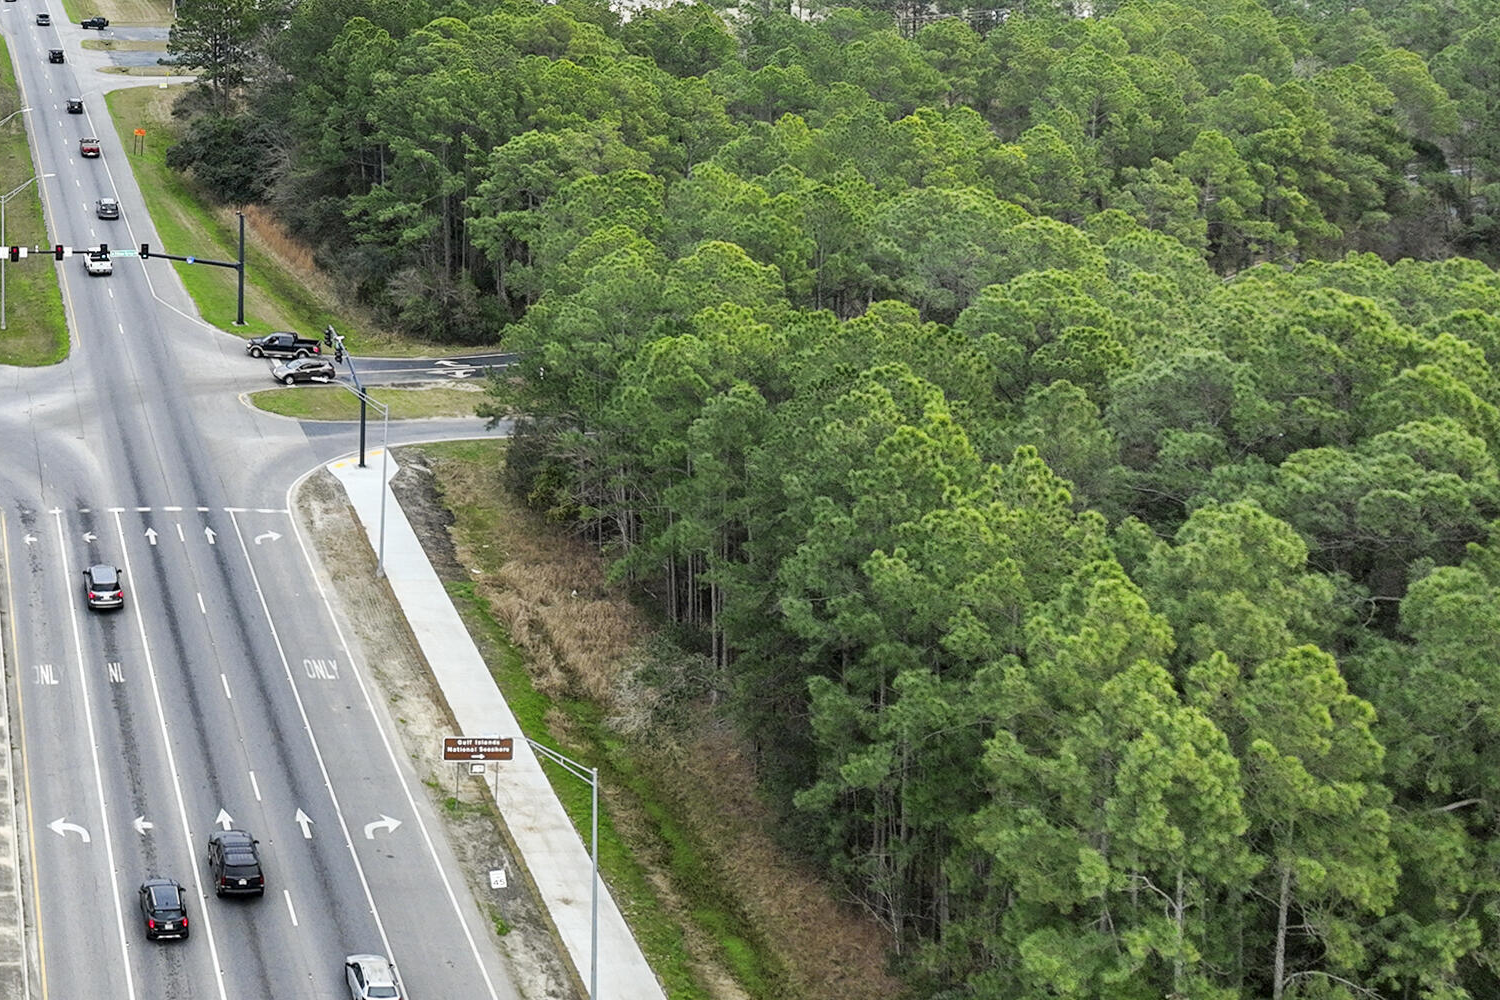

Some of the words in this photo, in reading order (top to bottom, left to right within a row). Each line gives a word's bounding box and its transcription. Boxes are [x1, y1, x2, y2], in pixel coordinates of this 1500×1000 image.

[32, 664, 61, 685] ONL
[107, 662, 126, 683] NL
[303, 659, 340, 680] ONLY
